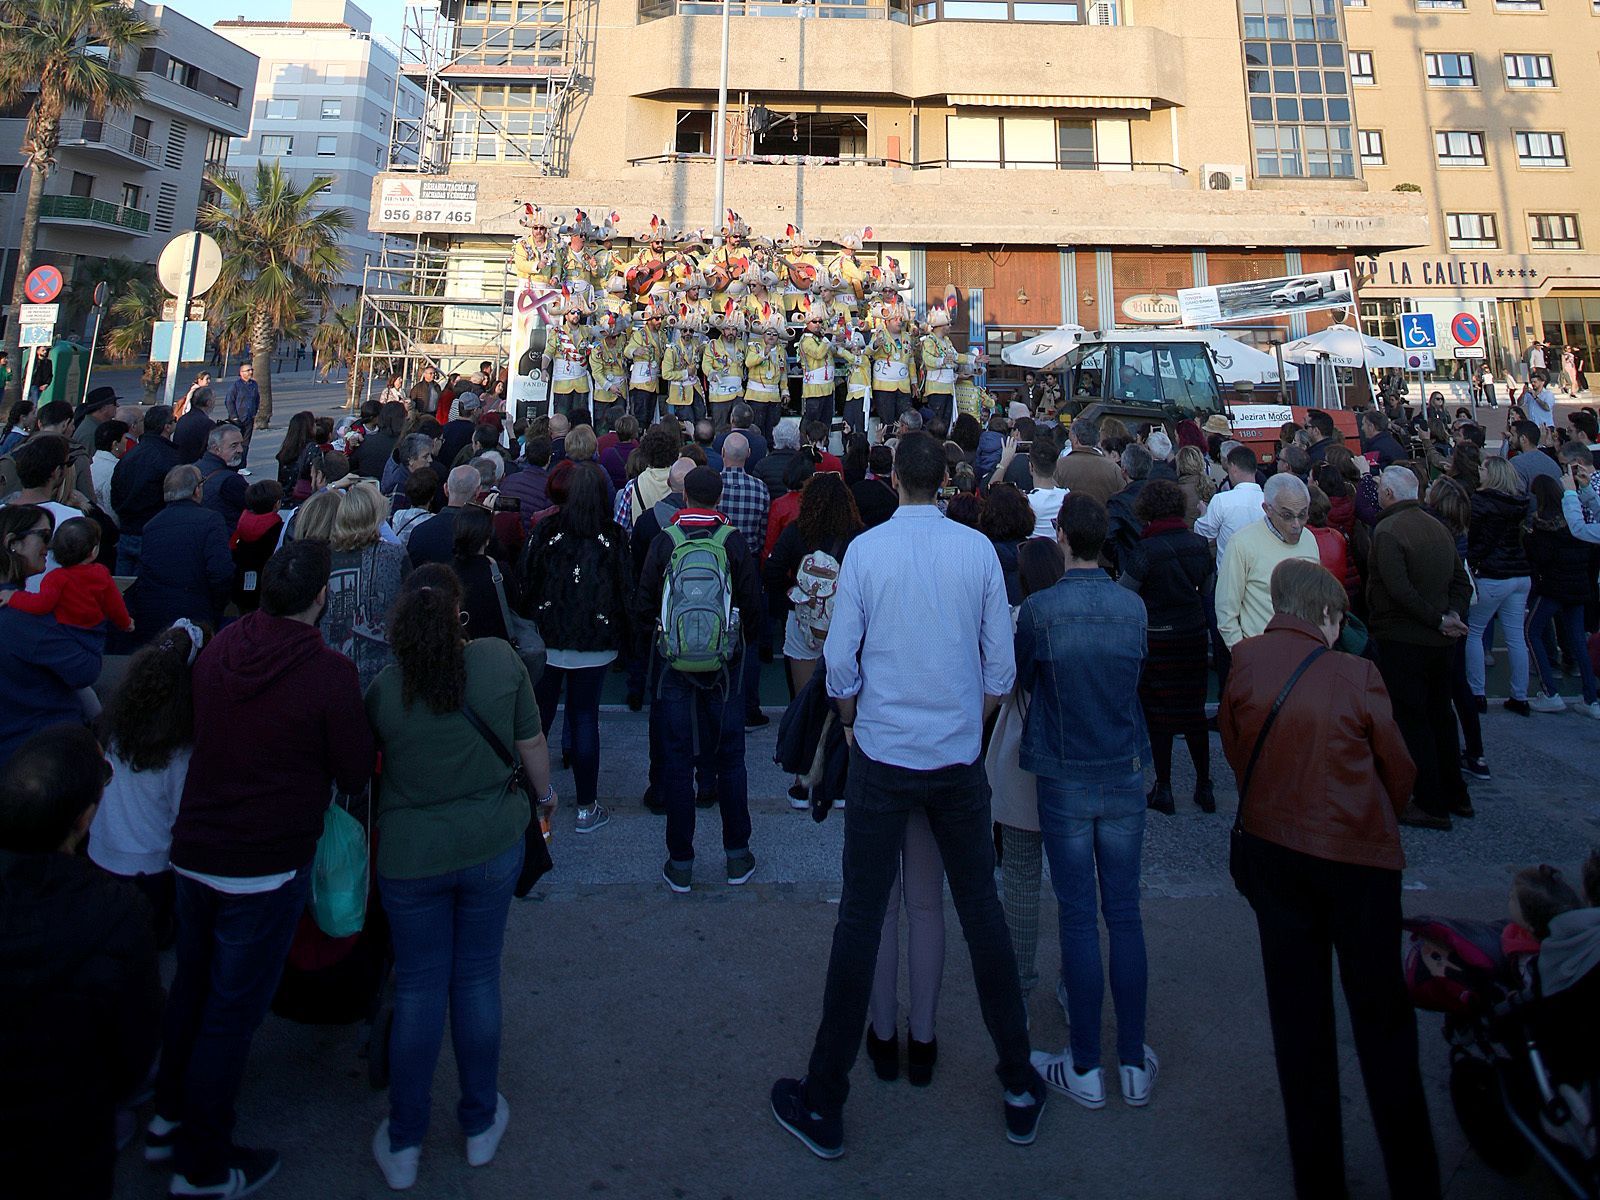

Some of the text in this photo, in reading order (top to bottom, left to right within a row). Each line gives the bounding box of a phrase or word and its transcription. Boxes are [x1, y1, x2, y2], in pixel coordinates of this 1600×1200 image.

[384, 209, 472, 222] 956 887 465
[1389, 261, 1412, 284] LA
[1423, 261, 1493, 284] CALETA
[1240, 412, 1291, 421] Jezirat Motor
[1239, 430, 1257, 438] 1180
